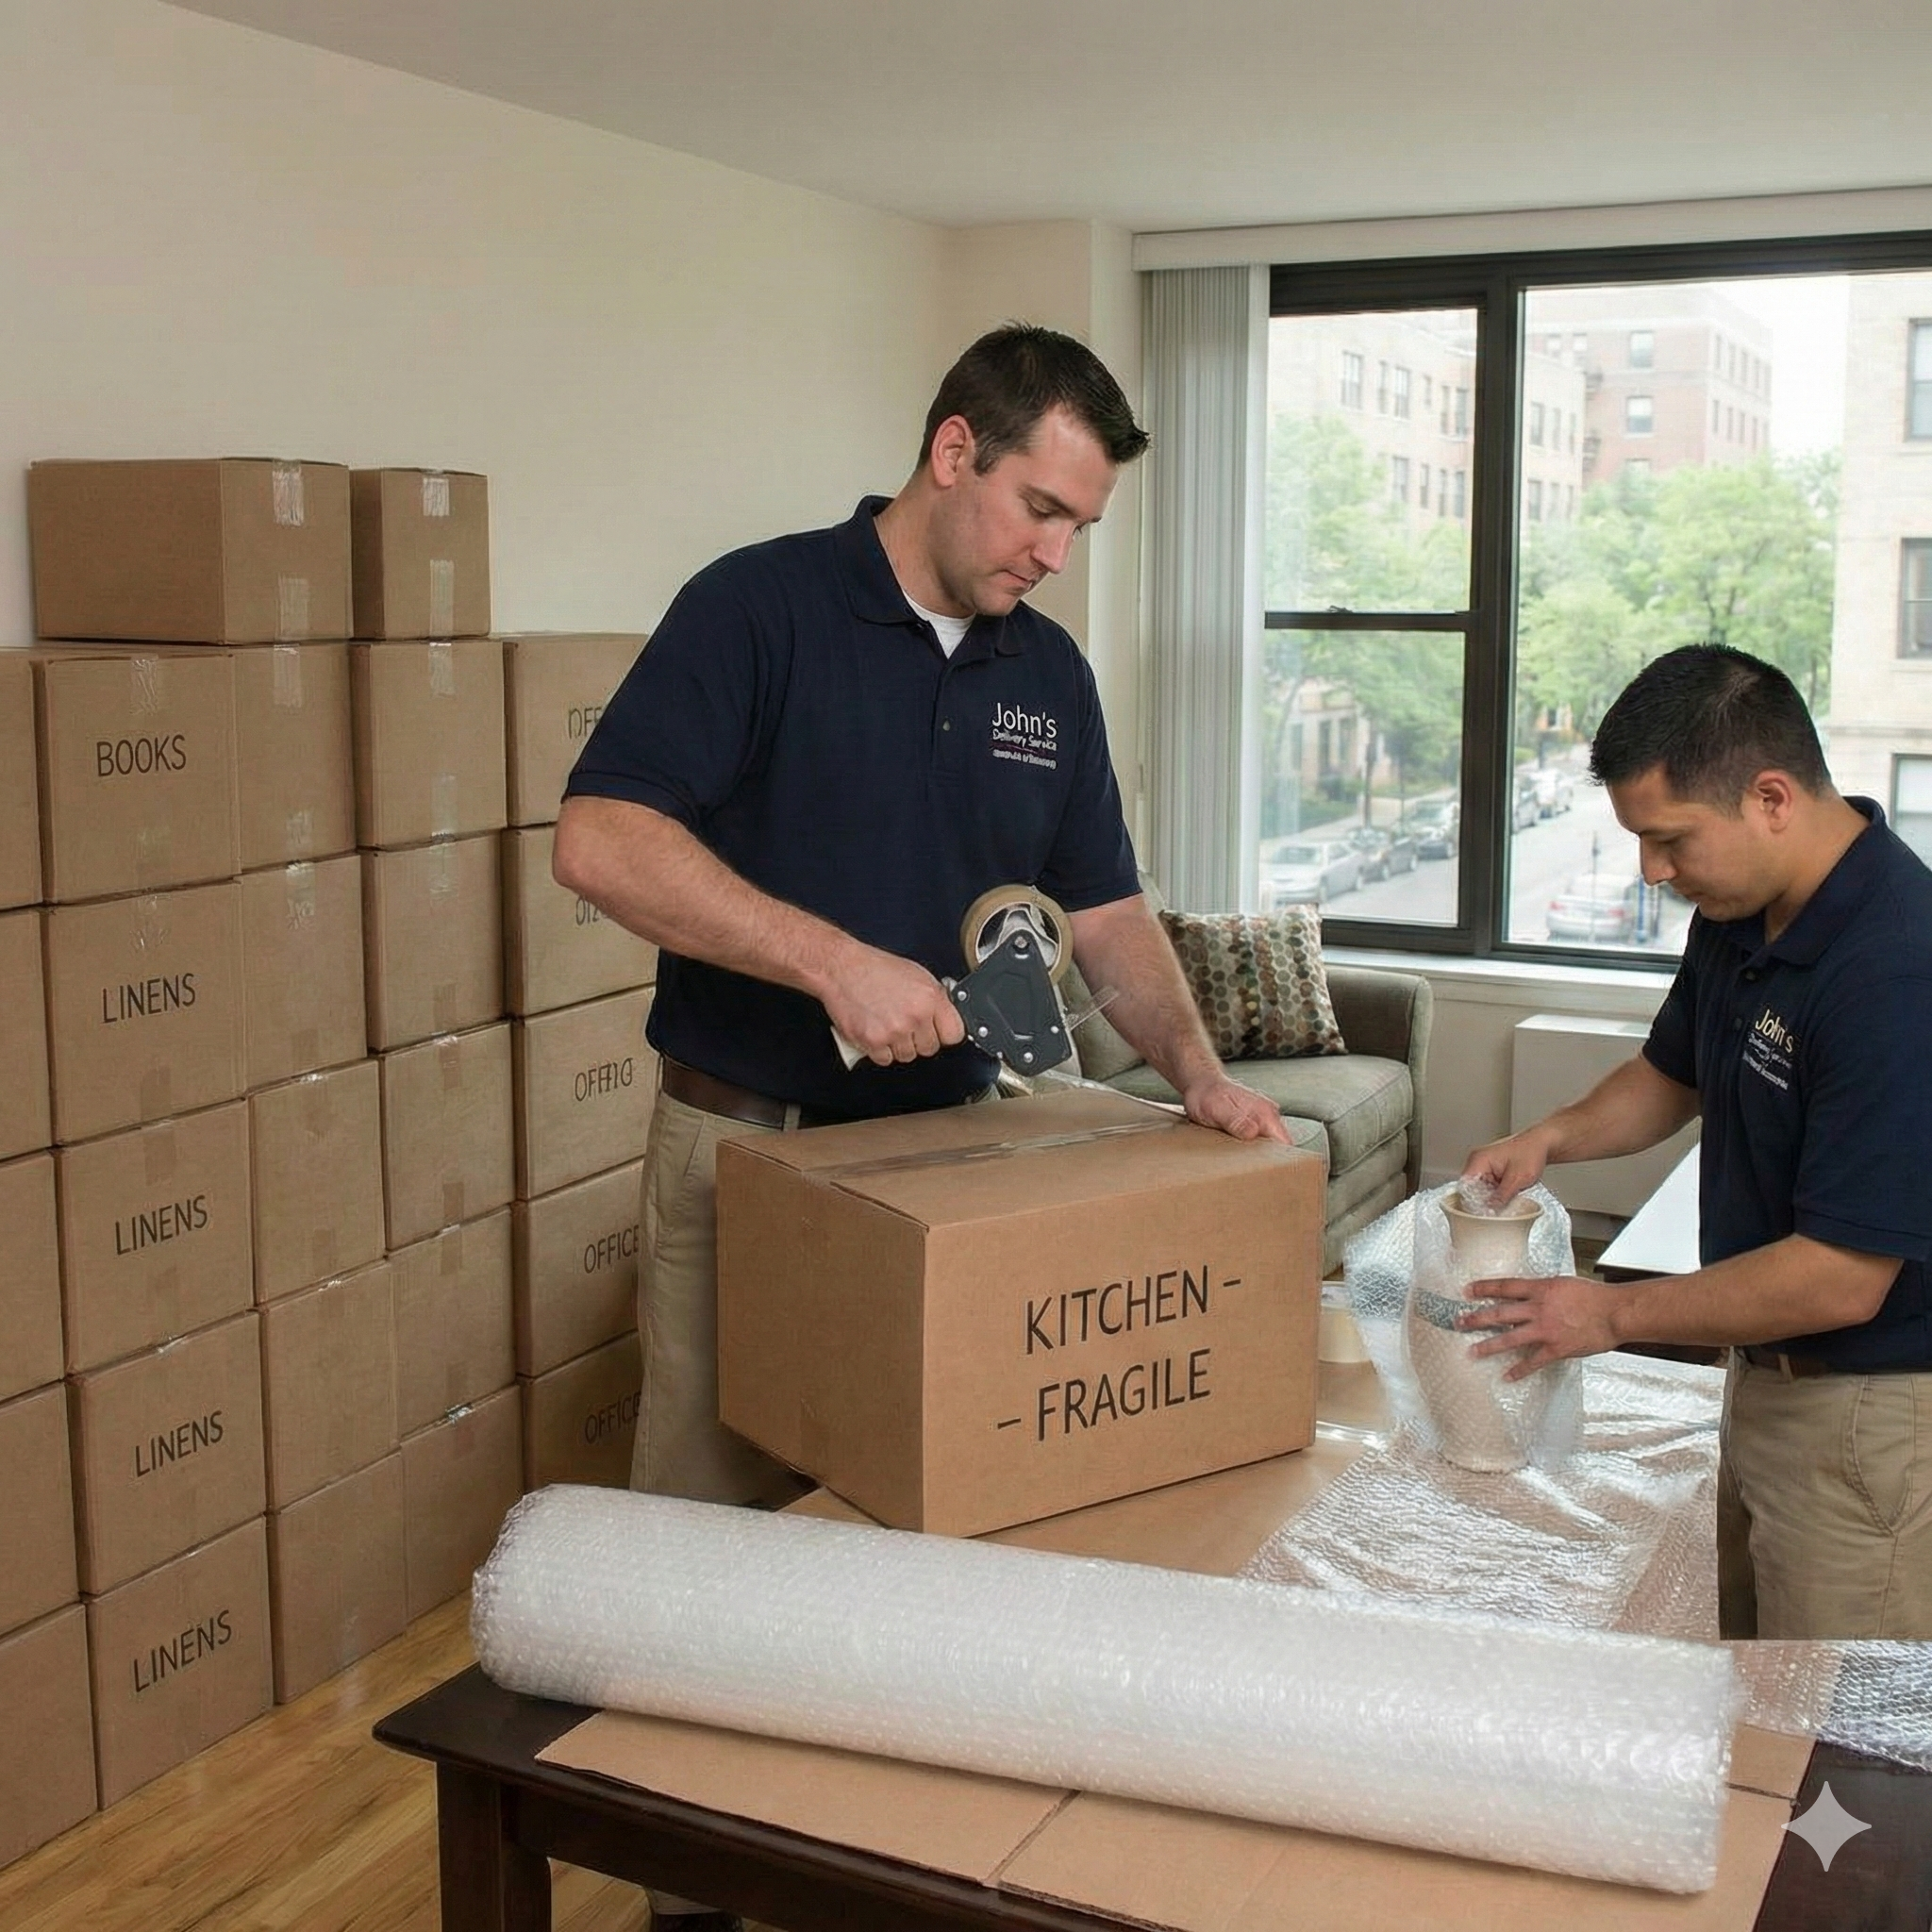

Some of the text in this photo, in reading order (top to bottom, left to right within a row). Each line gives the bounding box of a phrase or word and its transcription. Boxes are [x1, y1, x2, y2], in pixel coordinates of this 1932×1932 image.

[991, 702, 1058, 739] John's
[96, 735, 187, 777] BOOKS
[103, 973, 196, 1024] LINENS
[115, 1194, 208, 1256] LINENS
[584, 1224, 640, 1274] OFFICE
[1026, 1265, 1208, 1355] KITCHEN
[1039, 1348, 1211, 1441] FRAGILE
[135, 1410, 224, 1478] LINENS
[134, 1609, 232, 1692] LINENS
